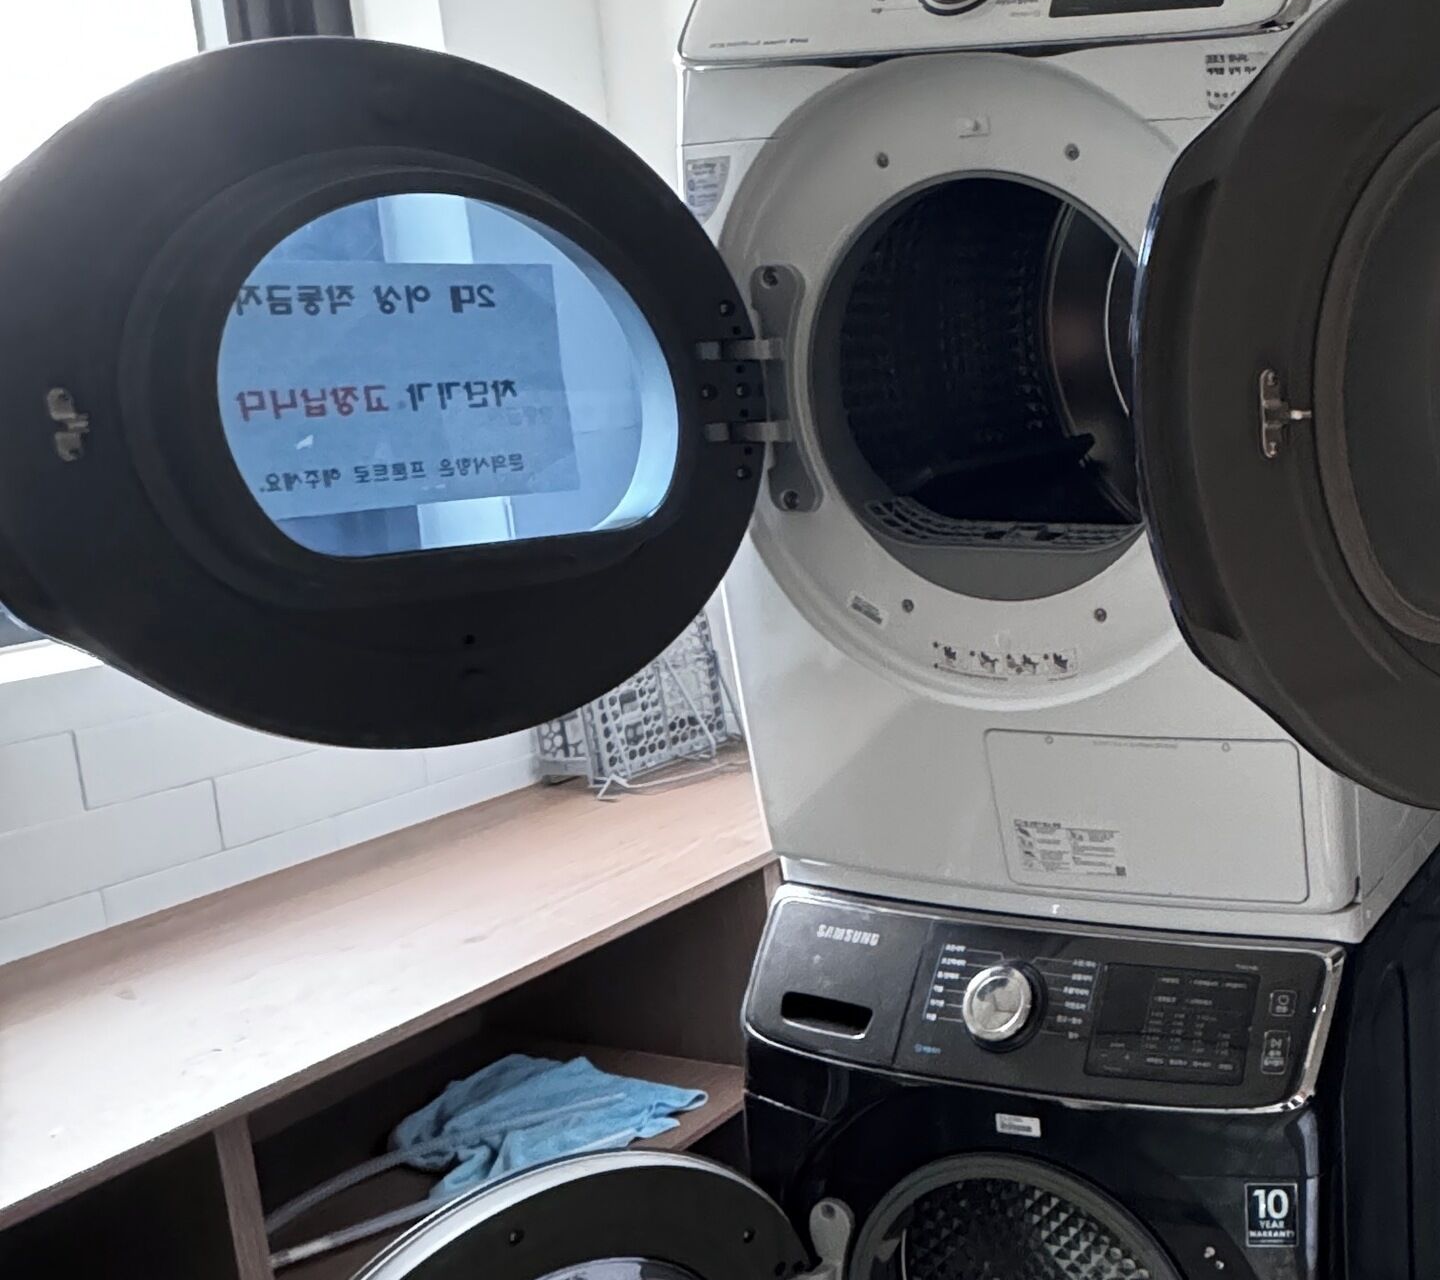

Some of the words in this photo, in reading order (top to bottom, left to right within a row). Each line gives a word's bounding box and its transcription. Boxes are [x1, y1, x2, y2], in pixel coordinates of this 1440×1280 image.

[816, 924, 880, 947] SAMSUNG
[1252, 1189, 1289, 1219] 10
[1259, 1220, 1284, 1229] YEAR
[1249, 1230, 1295, 1238] WARRANTY
